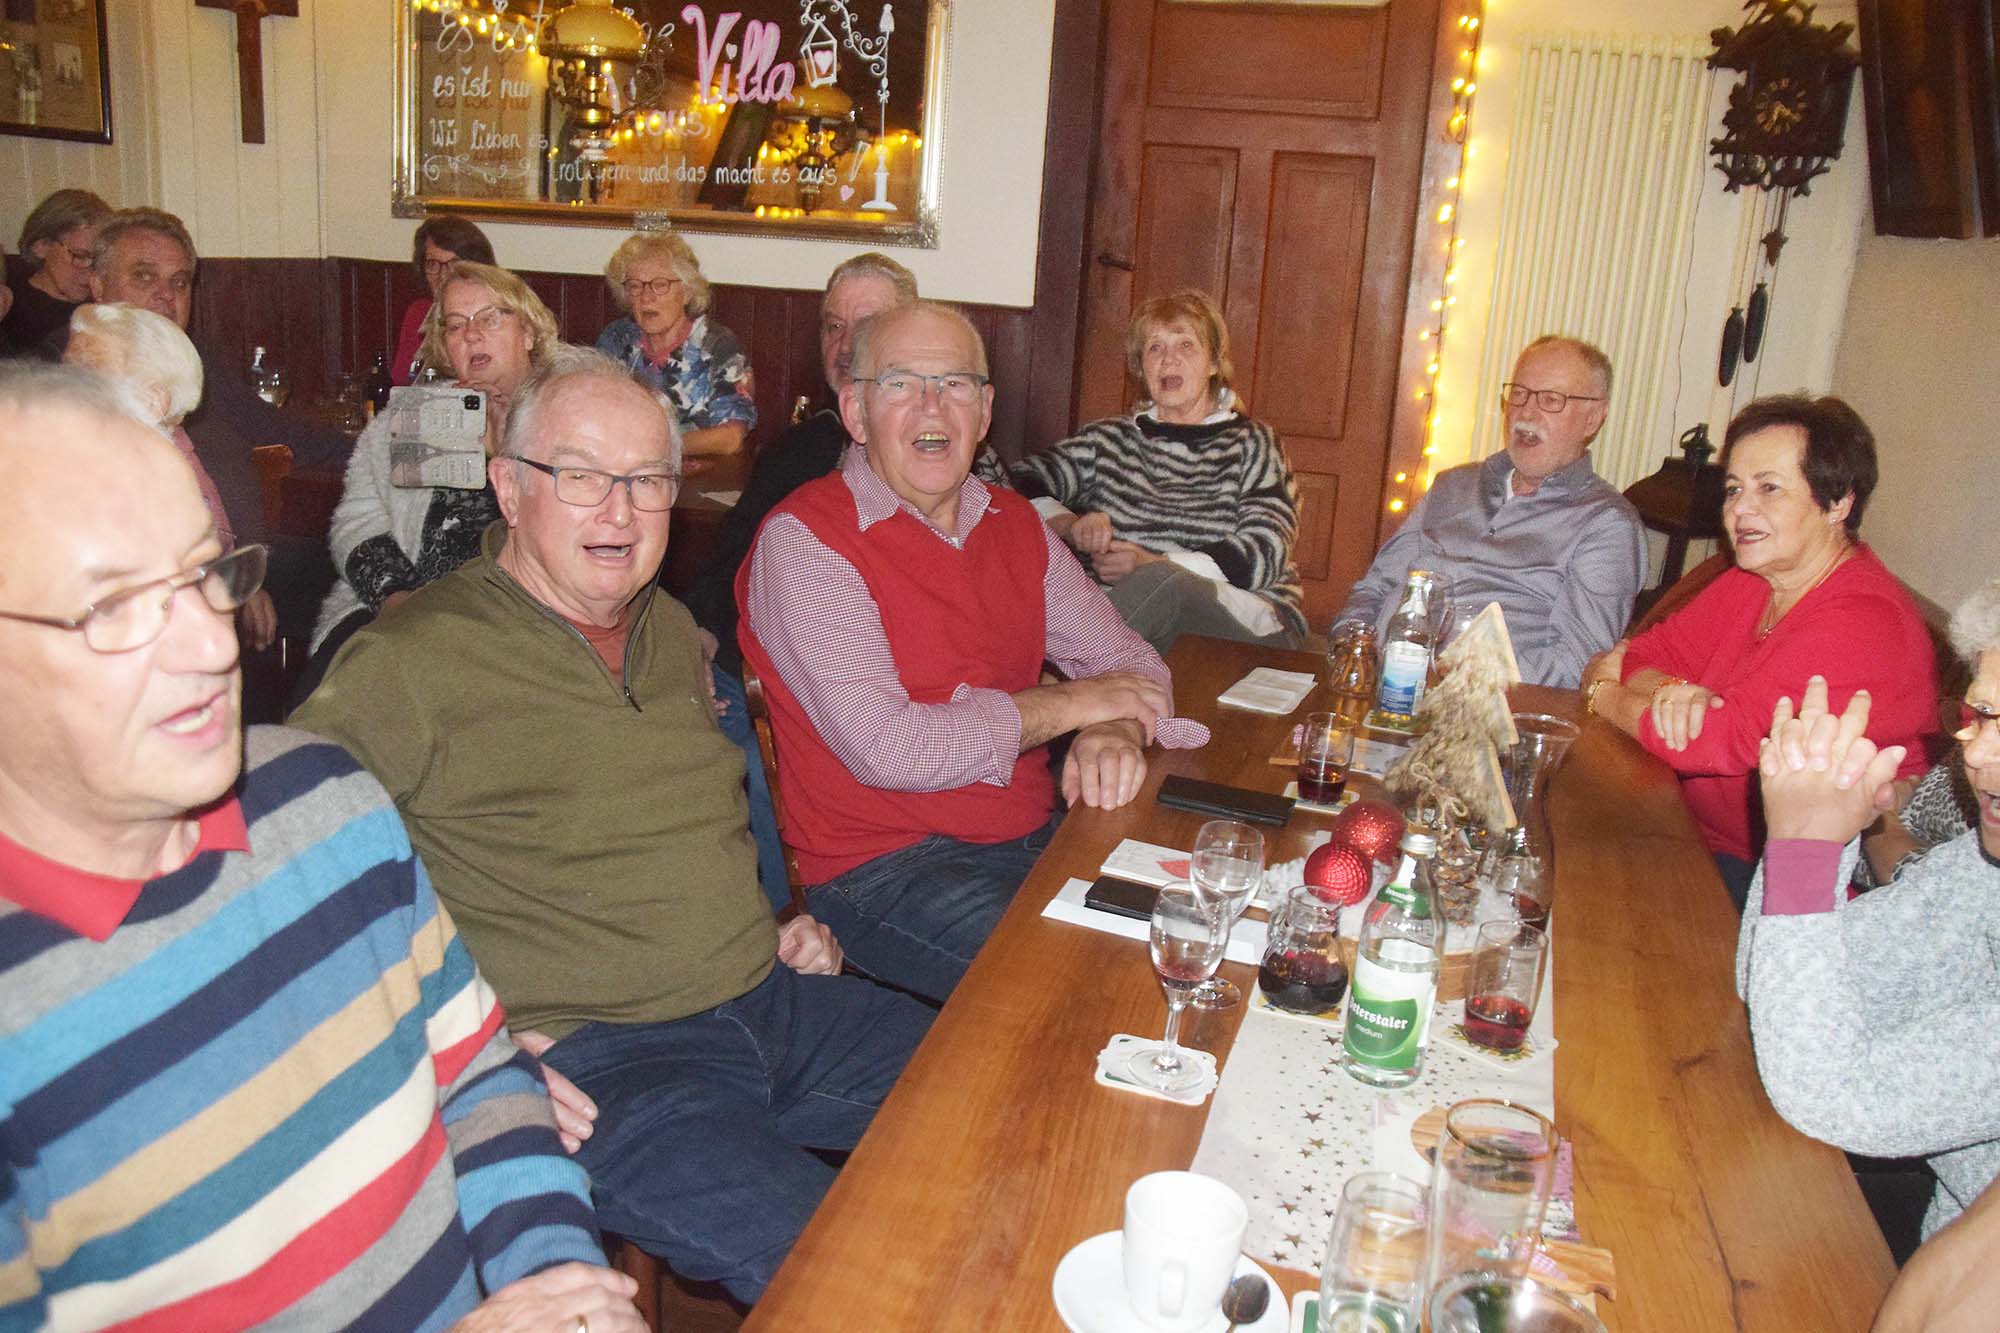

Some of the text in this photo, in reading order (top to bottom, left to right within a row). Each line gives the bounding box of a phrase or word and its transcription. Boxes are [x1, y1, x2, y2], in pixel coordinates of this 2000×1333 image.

[433, 74, 455, 98] es
[461, 65, 491, 98] ist
[639, 154, 669, 183] und
[674, 156, 706, 183] das
[715, 156, 765, 184] macht
[771, 165, 791, 184] es
